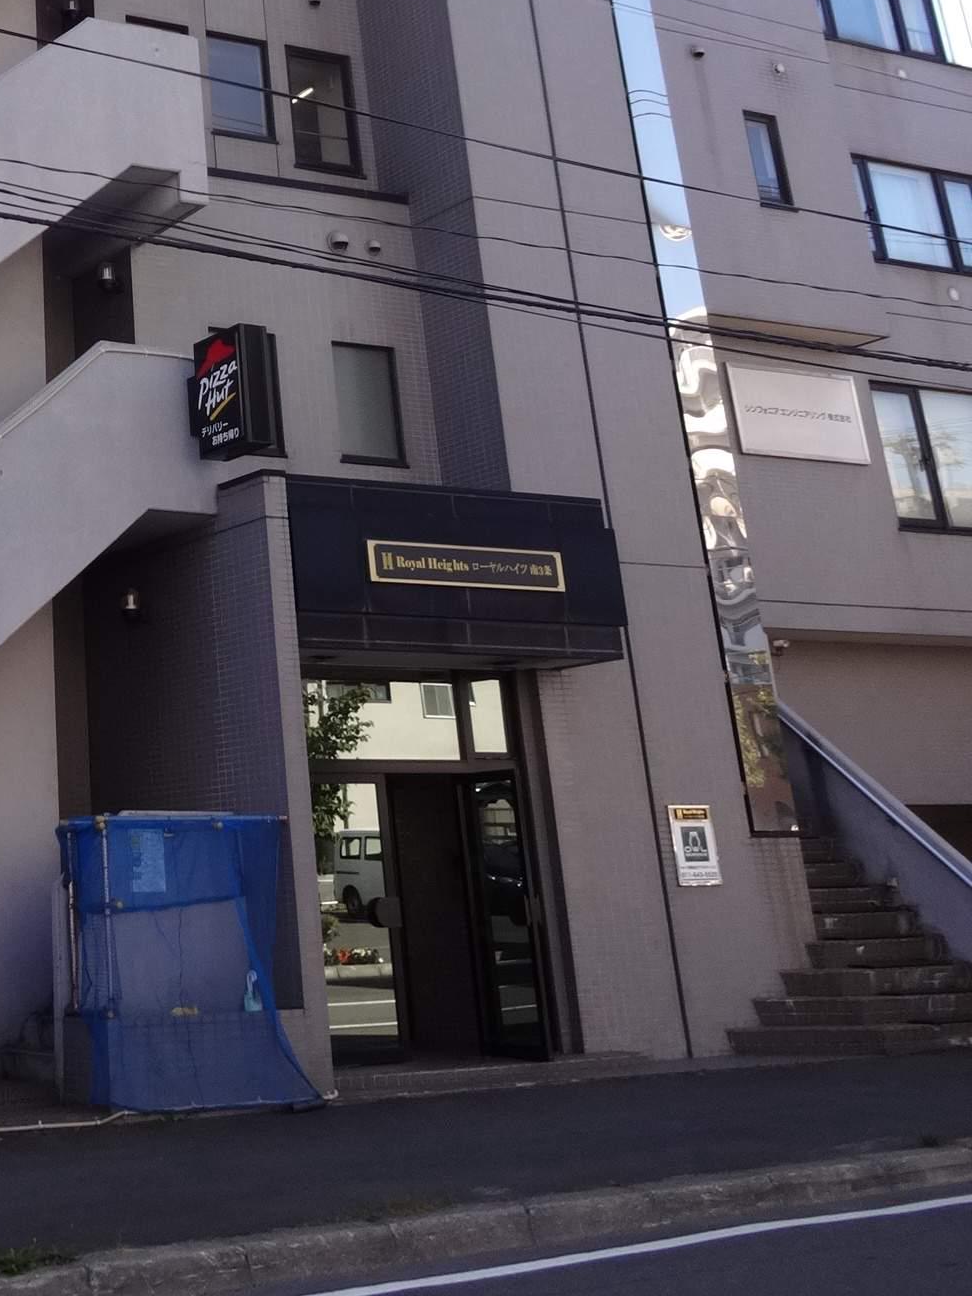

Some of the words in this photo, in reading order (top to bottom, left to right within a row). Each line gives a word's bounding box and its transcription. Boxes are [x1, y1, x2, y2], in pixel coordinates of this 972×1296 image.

[197, 360, 238, 410] Pizza
[205, 379, 234, 416] Hut
[201, 421, 228, 437] デリバリー
[212, 427, 240, 446] お持ち帰り
[396, 555, 426, 572] Royal
[428, 557, 469, 573] Heights
[472, 562, 527, 575] ローヤルハイツ
